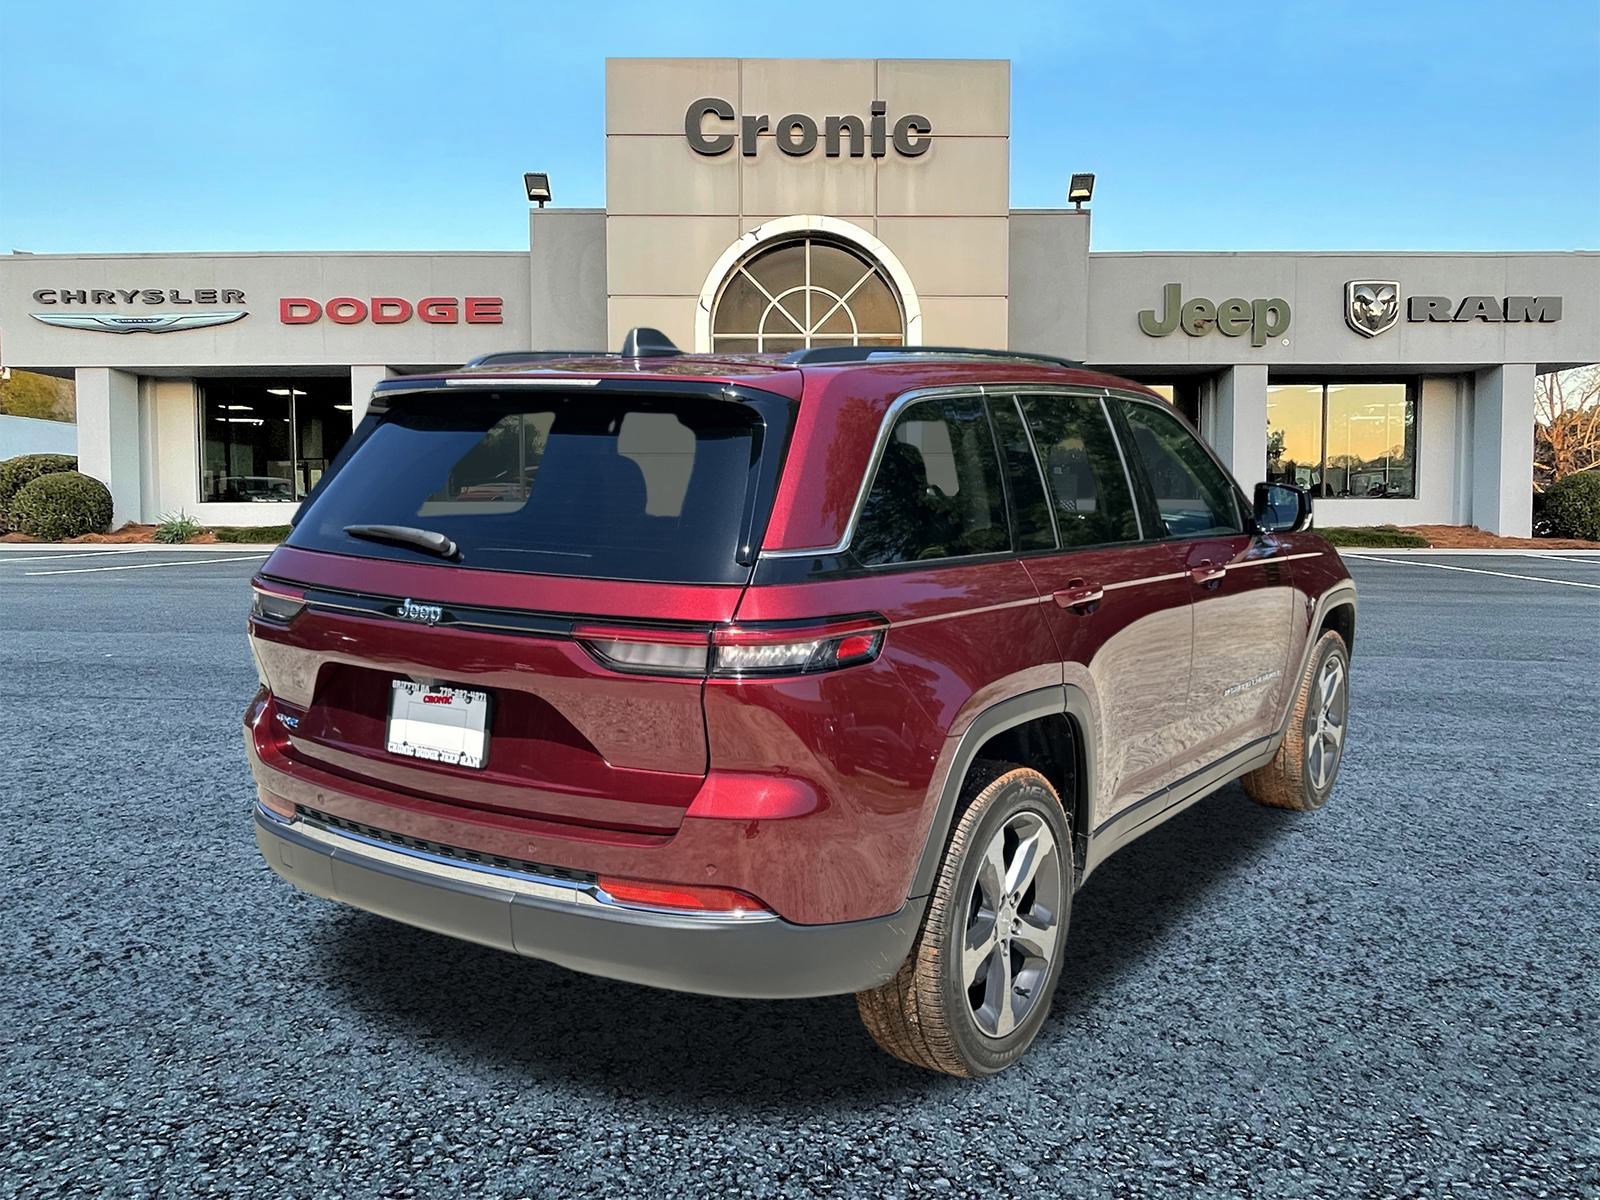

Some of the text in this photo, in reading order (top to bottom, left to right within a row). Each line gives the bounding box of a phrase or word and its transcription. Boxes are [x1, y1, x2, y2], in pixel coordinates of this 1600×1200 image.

[685, 97, 932, 157] Cronic
[33, 289, 246, 305] CHRYSLER
[279, 297, 503, 324] DODGE
[1407, 296, 1562, 322] RAM
[1138, 283, 1291, 347] Jeep
[397, 598, 442, 626] Jeep
